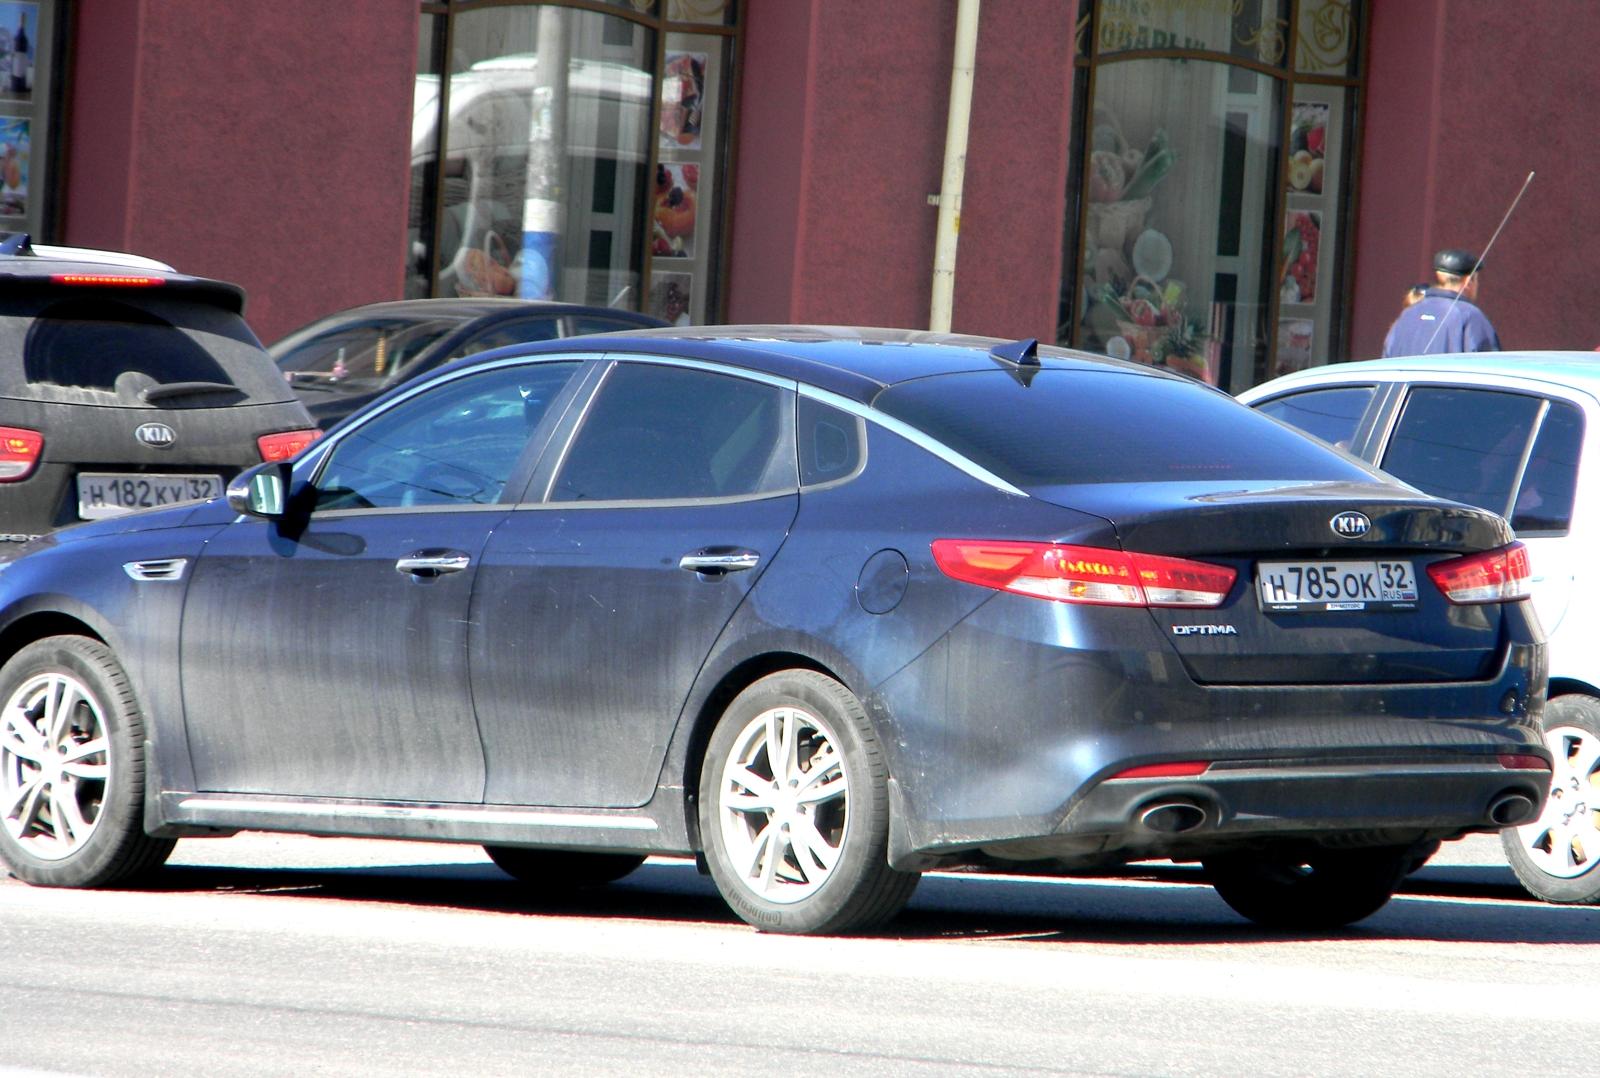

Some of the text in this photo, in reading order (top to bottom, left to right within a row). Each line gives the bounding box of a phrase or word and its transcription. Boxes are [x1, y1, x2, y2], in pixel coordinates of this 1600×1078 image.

[142, 427, 172, 442] KIA
[188, 479, 212, 499] 32
[1338, 517, 1366, 532] KIA
[1381, 564, 1408, 588] 32
[1383, 590, 1402, 600] RUS
[1172, 625, 1237, 635] OPTIMA
